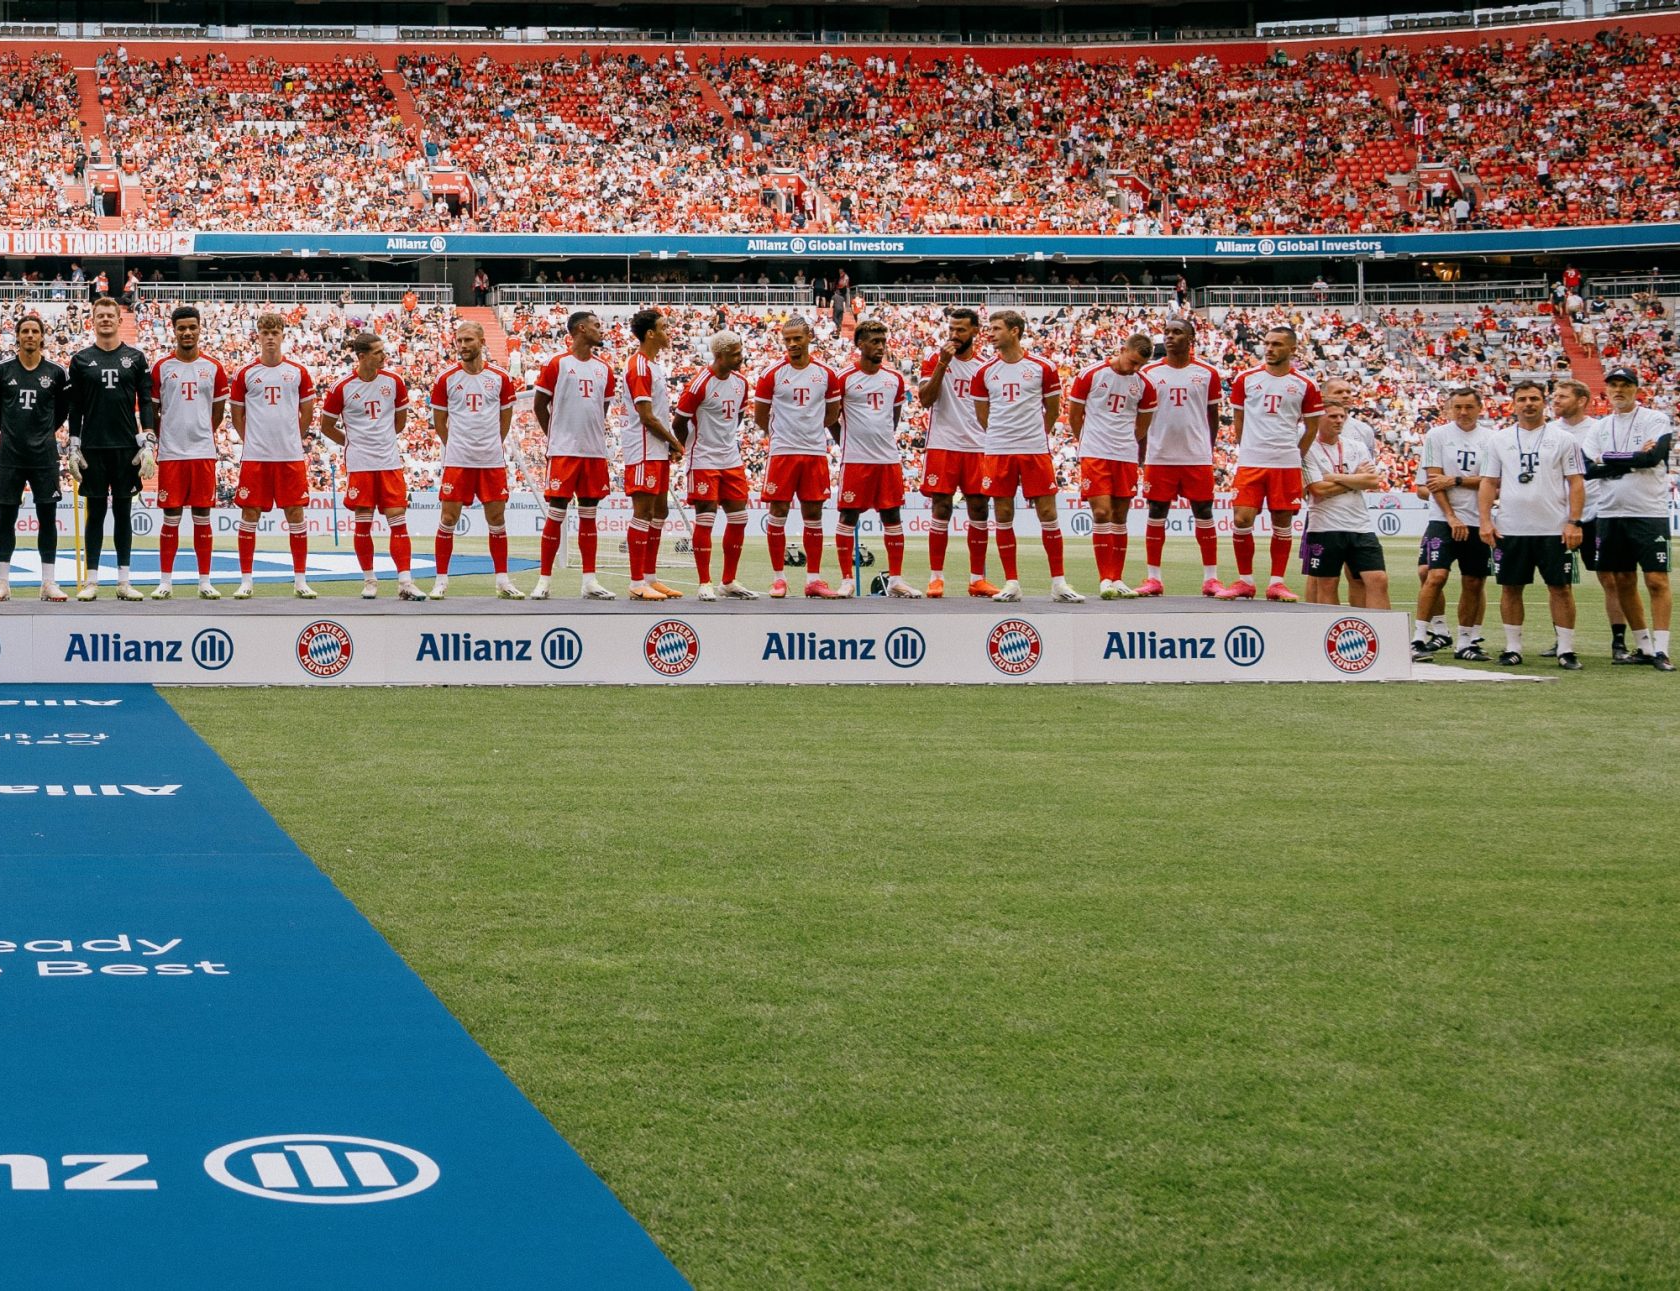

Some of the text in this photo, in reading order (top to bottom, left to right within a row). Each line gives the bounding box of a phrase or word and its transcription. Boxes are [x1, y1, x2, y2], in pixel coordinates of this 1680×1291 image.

[15, 233, 61, 254] BULLS
[65, 233, 171, 254] TAUBENBACH
[386, 238, 428, 249] Allianz
[747, 239, 904, 251] Allianz Global Investors
[1215, 239, 1381, 252] Allianz Global Investors
[302, 624, 347, 644] FC BAYERN
[649, 624, 694, 644] FC BAYERN
[992, 624, 1036, 644] FC BAYERN
[1330, 622, 1374, 642] FC BAYERN
[65, 634, 181, 663] Allianz
[417, 633, 530, 662] Allianz
[764, 633, 874, 661] Allianz
[1104, 632, 1215, 659] Allianz
[301, 653, 347, 672] MÜNCHEN
[648, 653, 694, 672] MÜNCHEN
[991, 652, 1036, 671] MÜNCHEN
[1329, 650, 1374, 669] MÜNCHEN
[38, 960, 230, 977] Best
